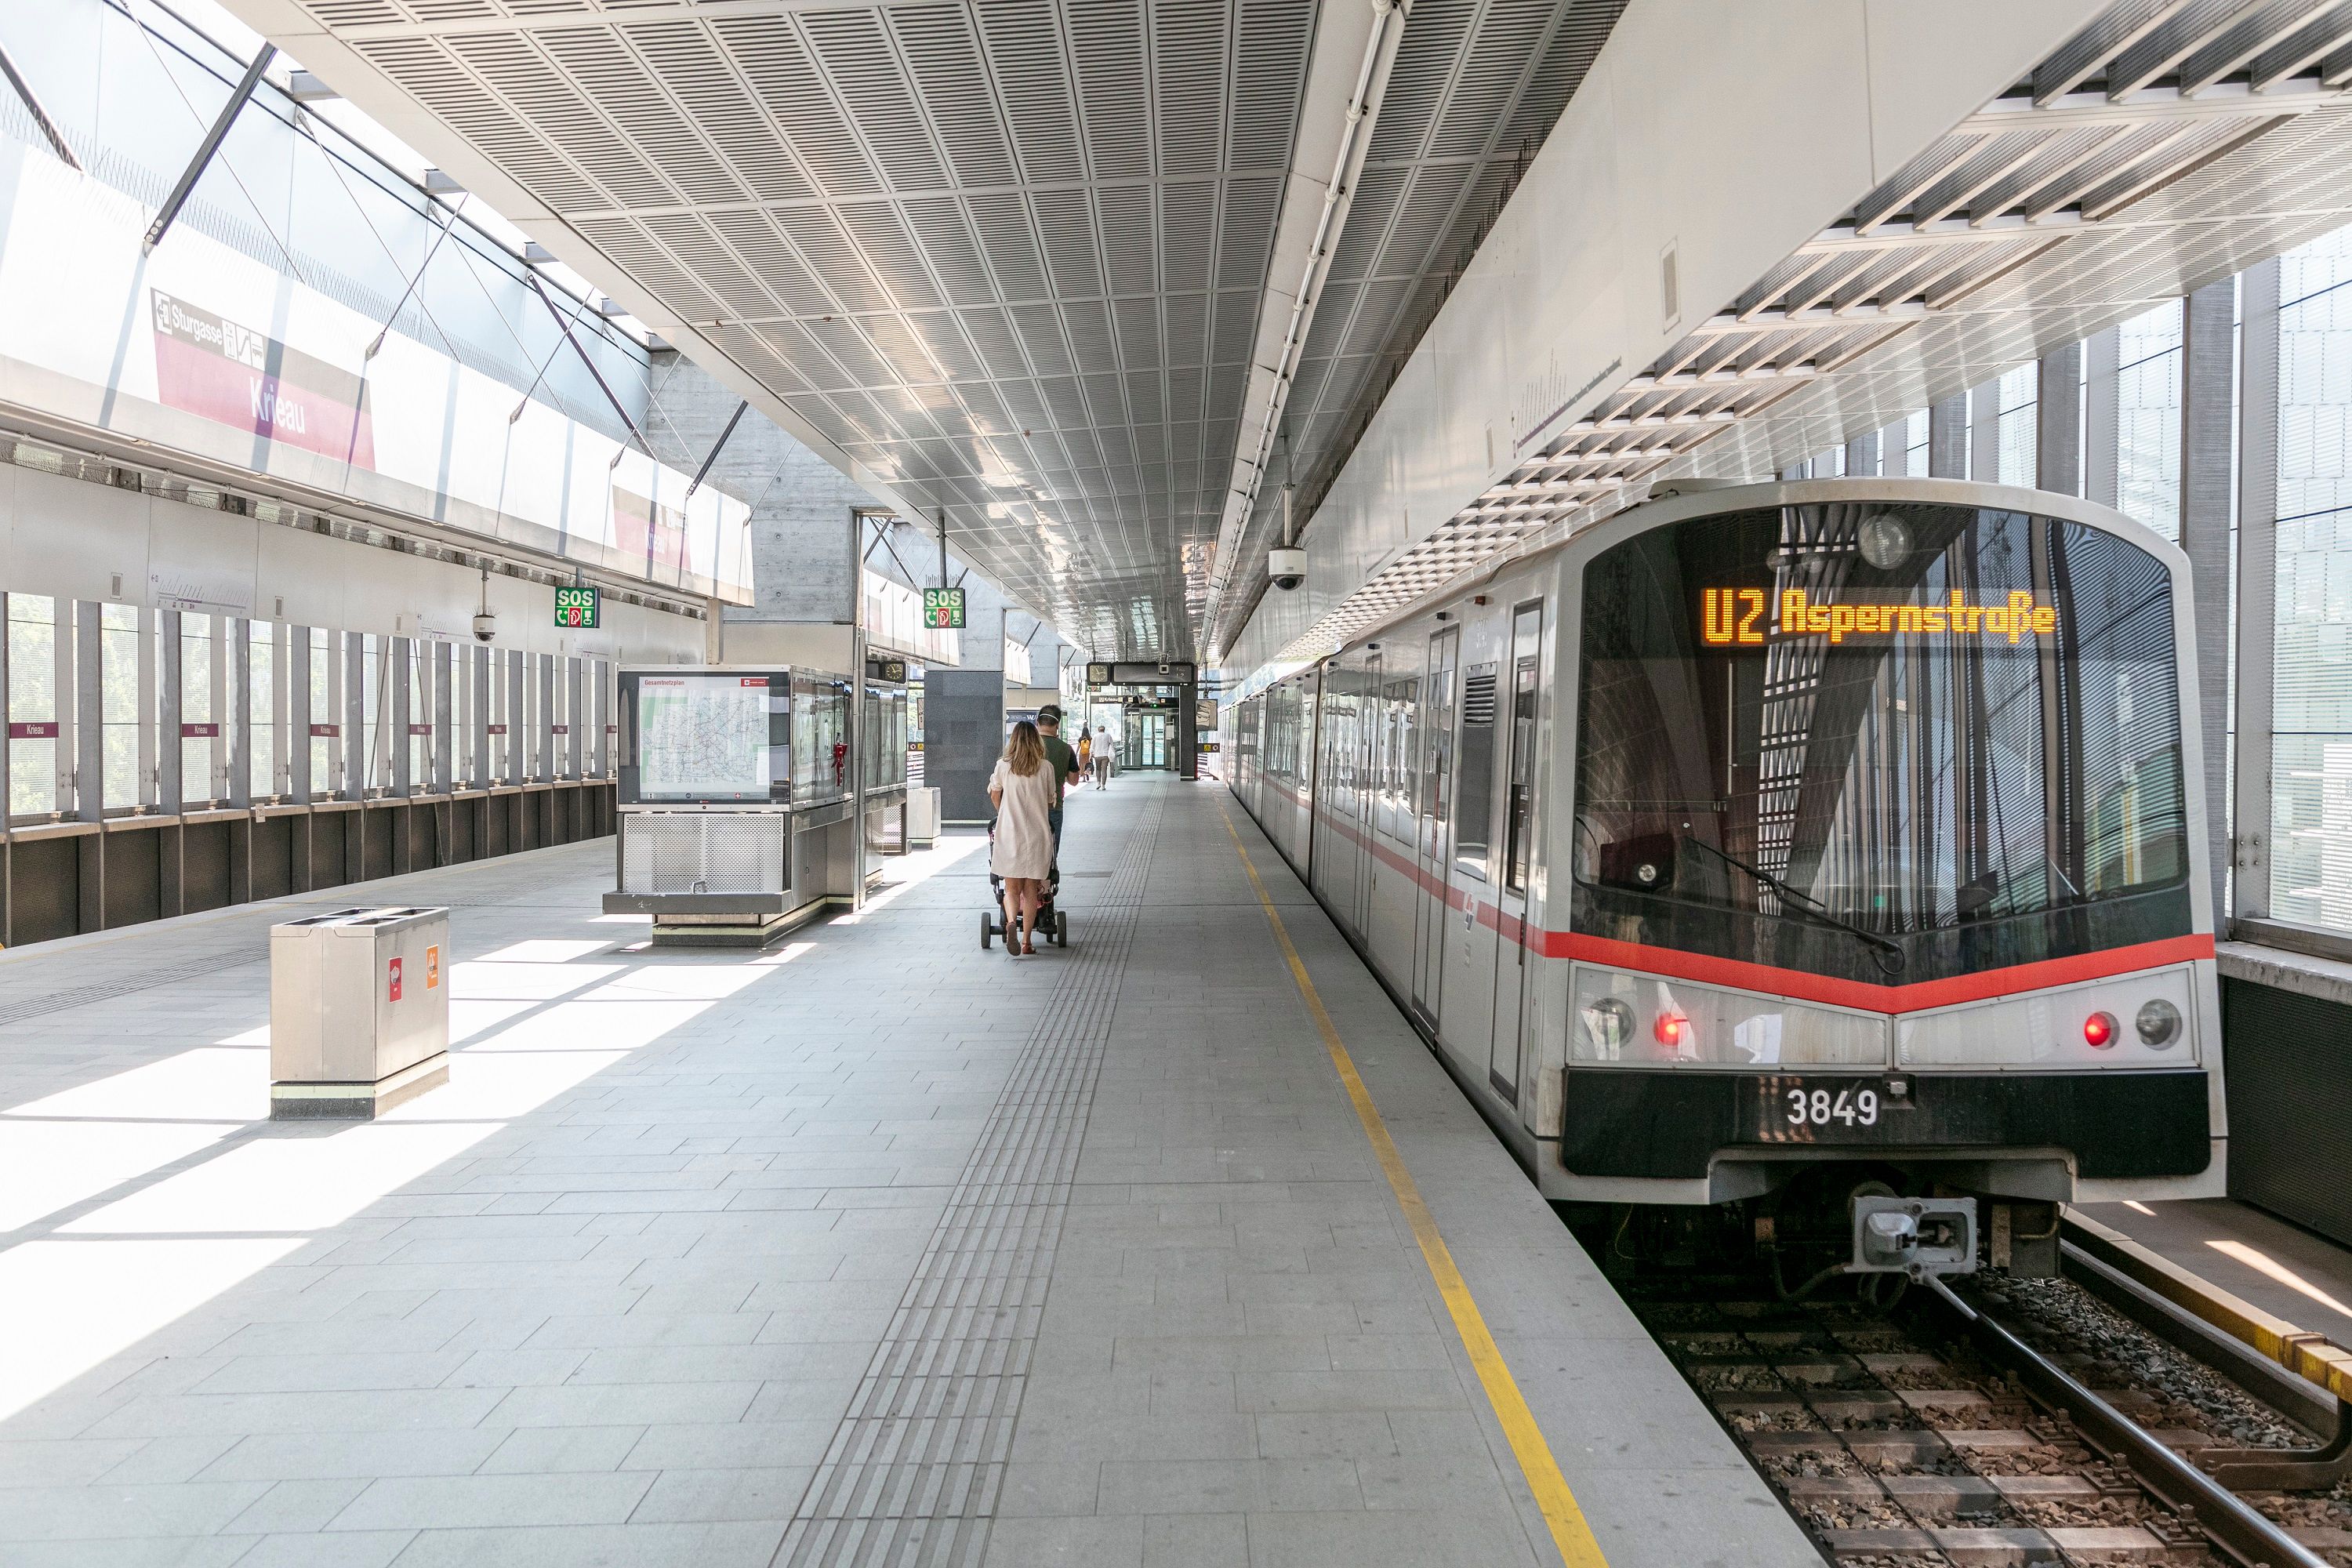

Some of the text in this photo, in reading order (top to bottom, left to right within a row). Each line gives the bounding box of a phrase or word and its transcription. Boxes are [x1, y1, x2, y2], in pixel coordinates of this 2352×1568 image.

[172, 304, 223, 345] Sturgasse
[249, 376, 305, 434] Krieau
[557, 590, 593, 606] SOS
[926, 590, 961, 607] SOS
[1705, 589, 2056, 644] U2 Aspernstraße
[27, 724, 44, 735] Krieau
[194, 725, 208, 735] Krieau
[1787, 1089, 1878, 1126] 3849
